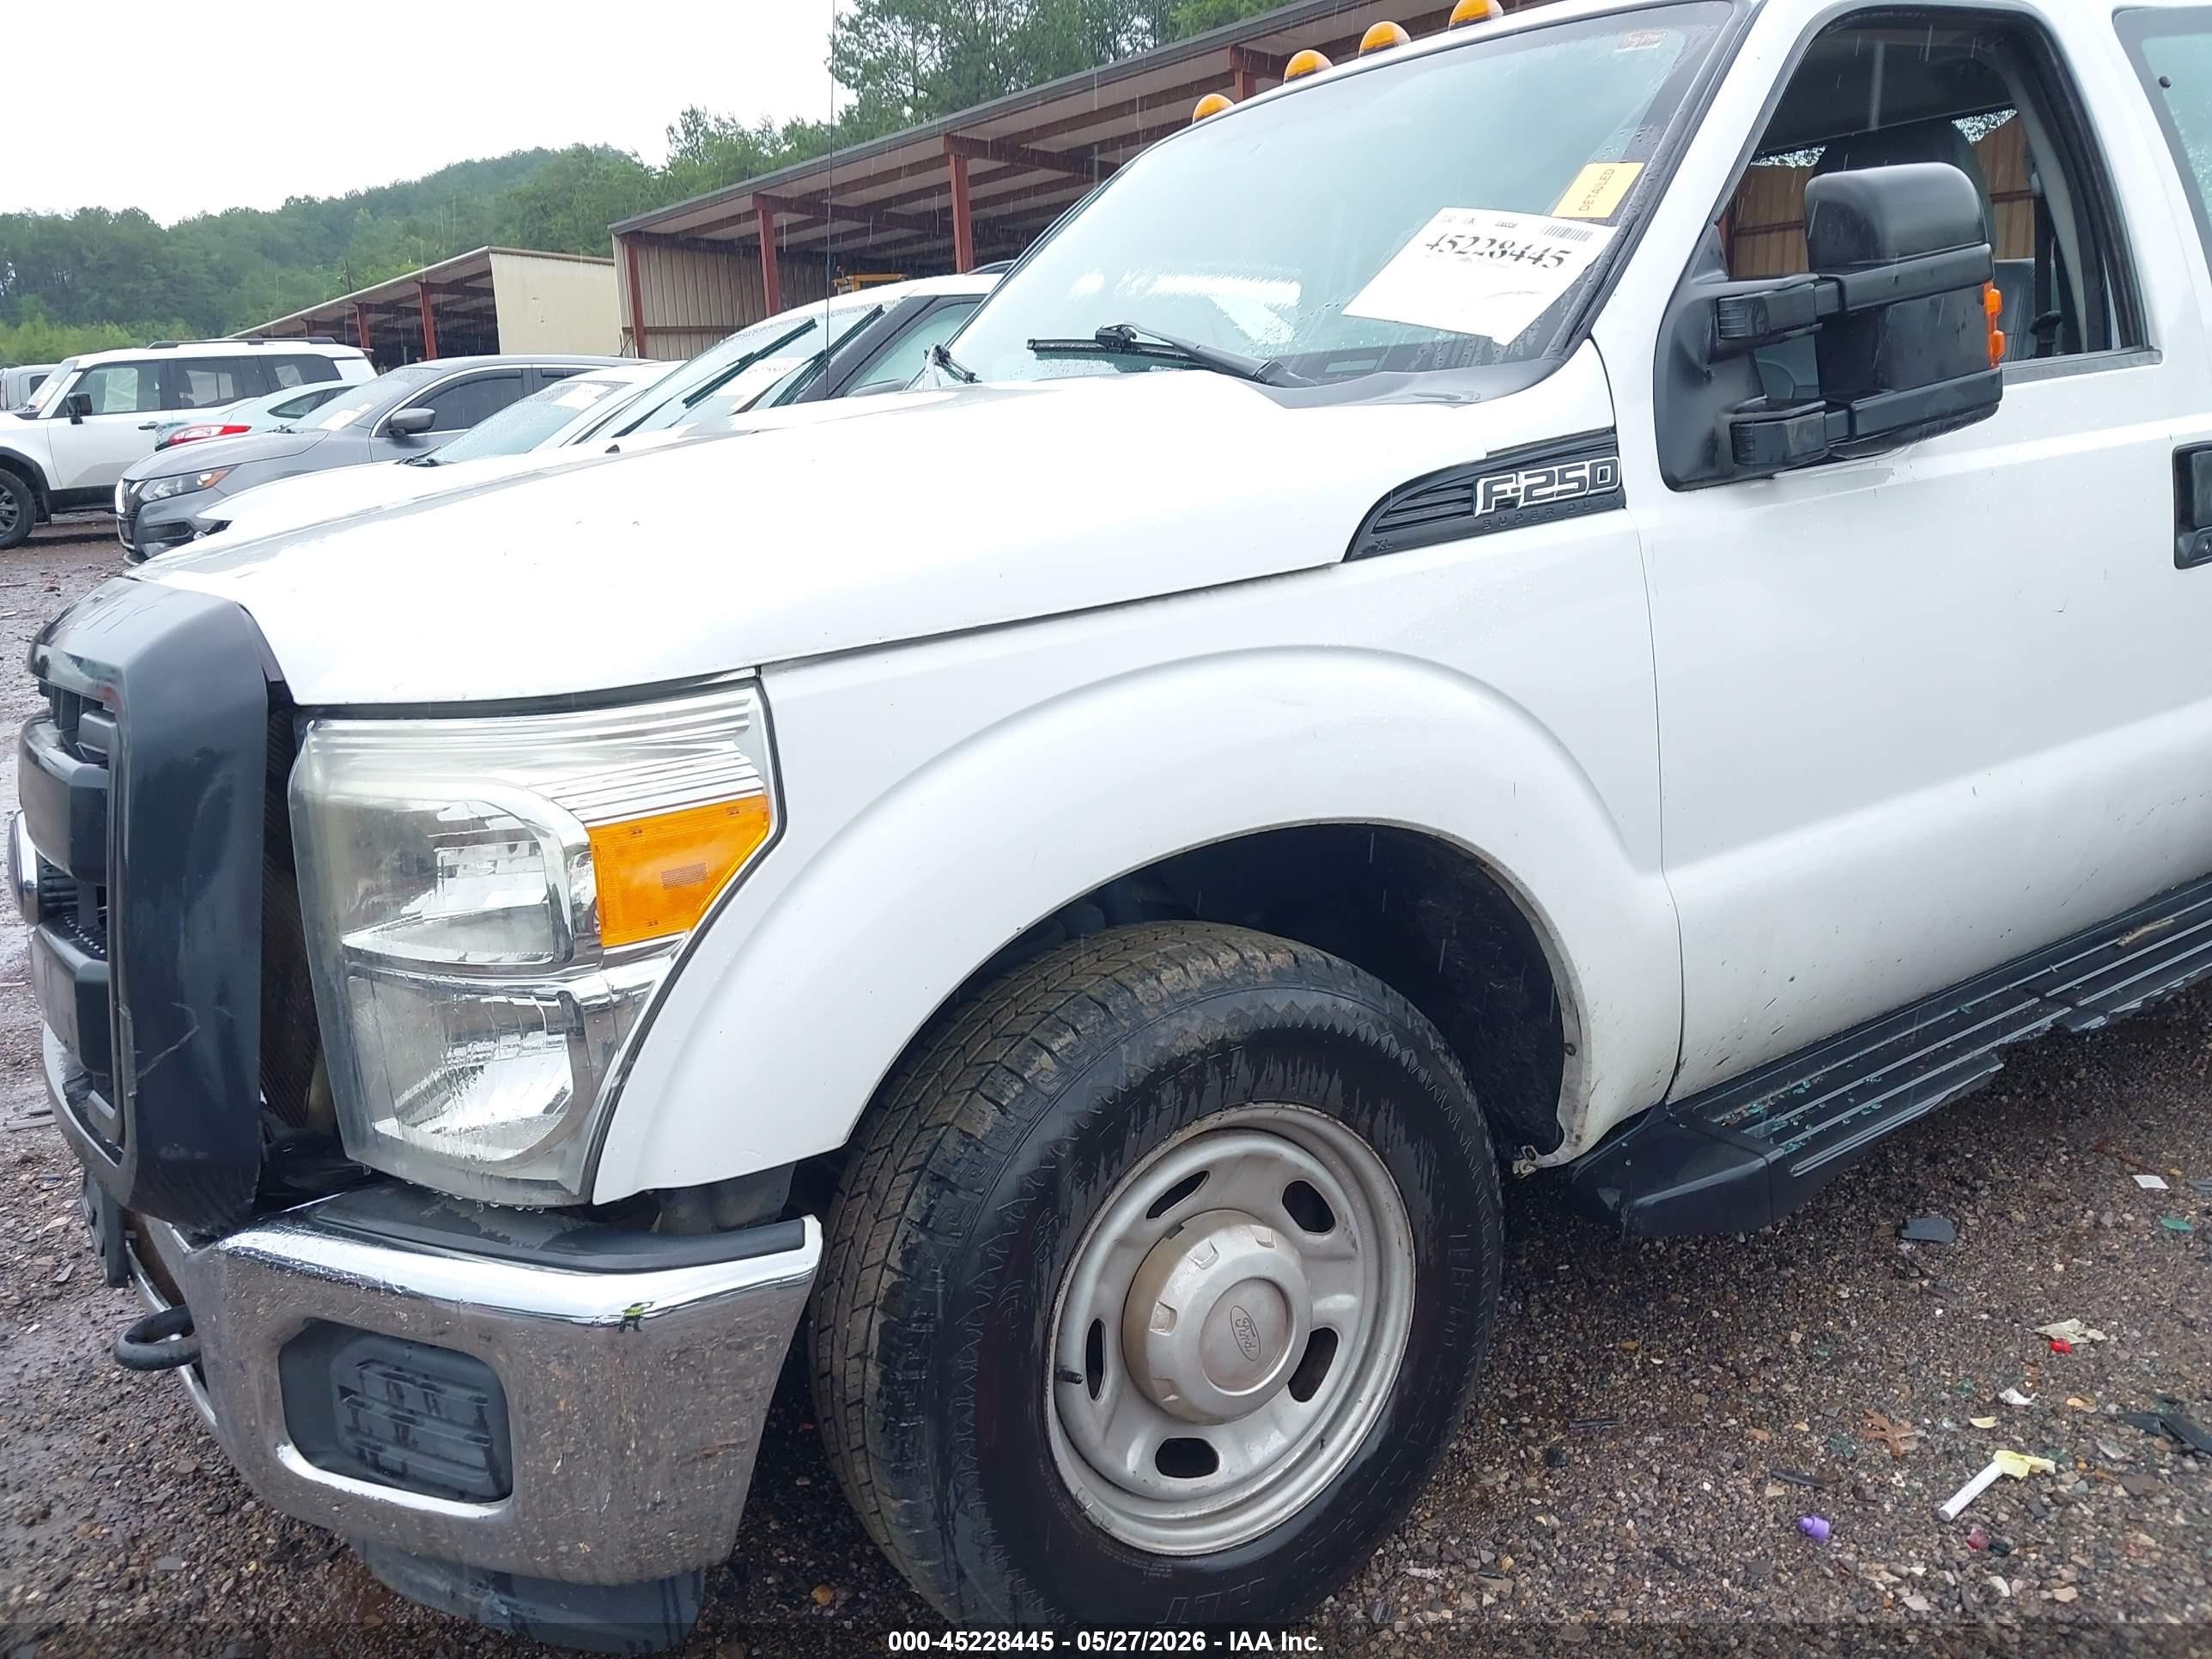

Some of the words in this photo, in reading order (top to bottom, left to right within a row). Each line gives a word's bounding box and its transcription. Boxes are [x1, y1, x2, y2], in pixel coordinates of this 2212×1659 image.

[1578, 168, 1615, 211] DETAILED
[1425, 233, 1573, 270] 45228445
[1474, 455, 1621, 519] F-250
[1483, 507, 1555, 531] SUPER
[1566, 494, 1621, 518] DUTY
[1374, 538, 1393, 551] XL
[1235, 1317, 1256, 1352] Ford
